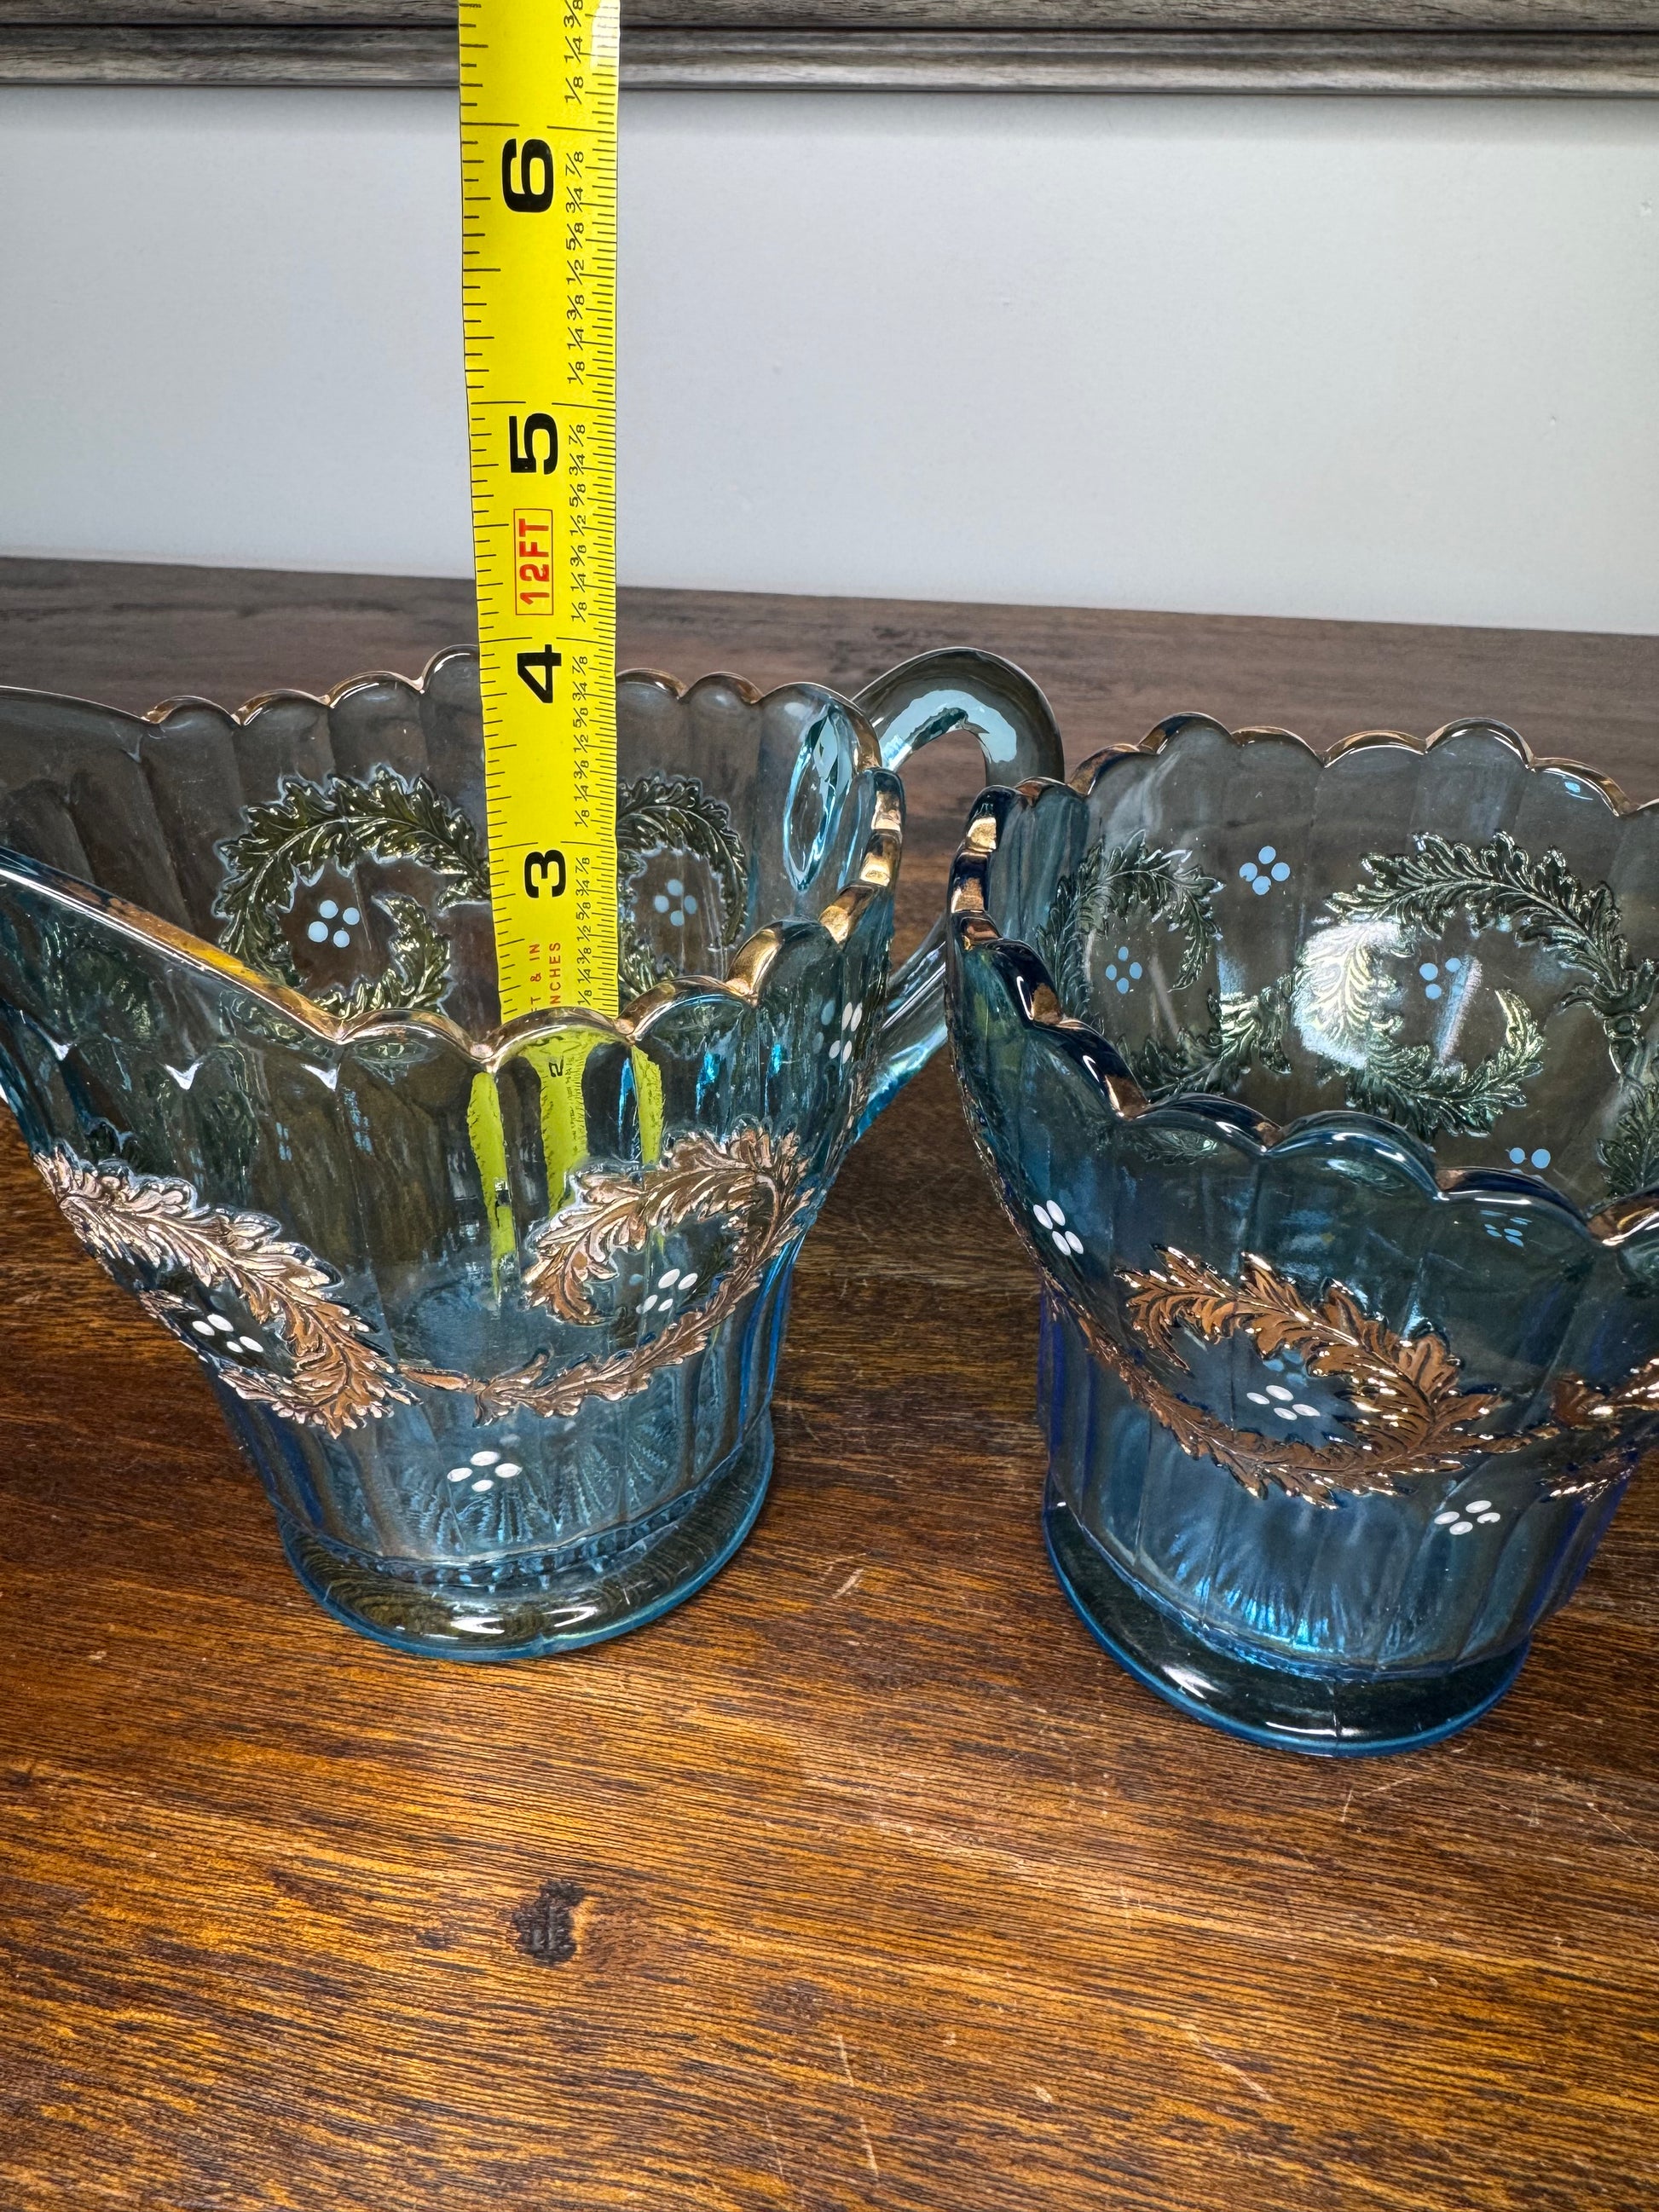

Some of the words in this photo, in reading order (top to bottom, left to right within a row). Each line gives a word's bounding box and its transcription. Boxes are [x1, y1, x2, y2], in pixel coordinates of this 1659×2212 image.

[564, 0, 584, 28] 3/8
[564, 36, 583, 63] 1/4
[564, 76, 584, 104] 1/8
[501, 138, 554, 213] 6
[565, 151, 584, 178] 7/8
[566, 187, 584, 213] 3/4
[566, 222, 585, 250] 5/8
[566, 259, 585, 286] 1/2
[567, 295, 585, 321] 3/8
[567, 326, 585, 350] 1/4
[567, 361, 586, 384] 1/8
[508, 413, 558, 475] 5
[569, 424, 586, 448] 7/8
[569, 453, 586, 476] 3/4
[569, 483, 587, 507] 5/8
[569, 515, 587, 536] 1/2
[518, 517, 550, 605] 12FT
[570, 545, 587, 567] 3/8
[570, 572, 587, 592] 1/4
[571, 602, 587, 622] 1/8
[517, 644, 562, 703] 4
[572, 656, 587, 676] 7/8
[572, 681, 587, 701] 3/4
[573, 707, 589, 728] 5/8
[573, 734, 589, 754] 1/2
[574, 759, 590, 779] 3/8
[574, 783, 589, 802] 1/4
[575, 810, 590, 828] 1/8
[524, 849, 567, 898] 3
[575, 857, 590, 875] 7/8
[575, 879, 590, 896] 3/4
[575, 902, 591, 920] 5/8
[577, 925, 592, 942] 1/2
[529, 944, 540, 962] IN
[576, 947, 592, 964] 3/8
[529, 973, 541, 982] &
[549, 942, 561, 1005] NCHES
[577, 968, 591, 984] 1/4
[577, 990, 592, 1006] 1/8
